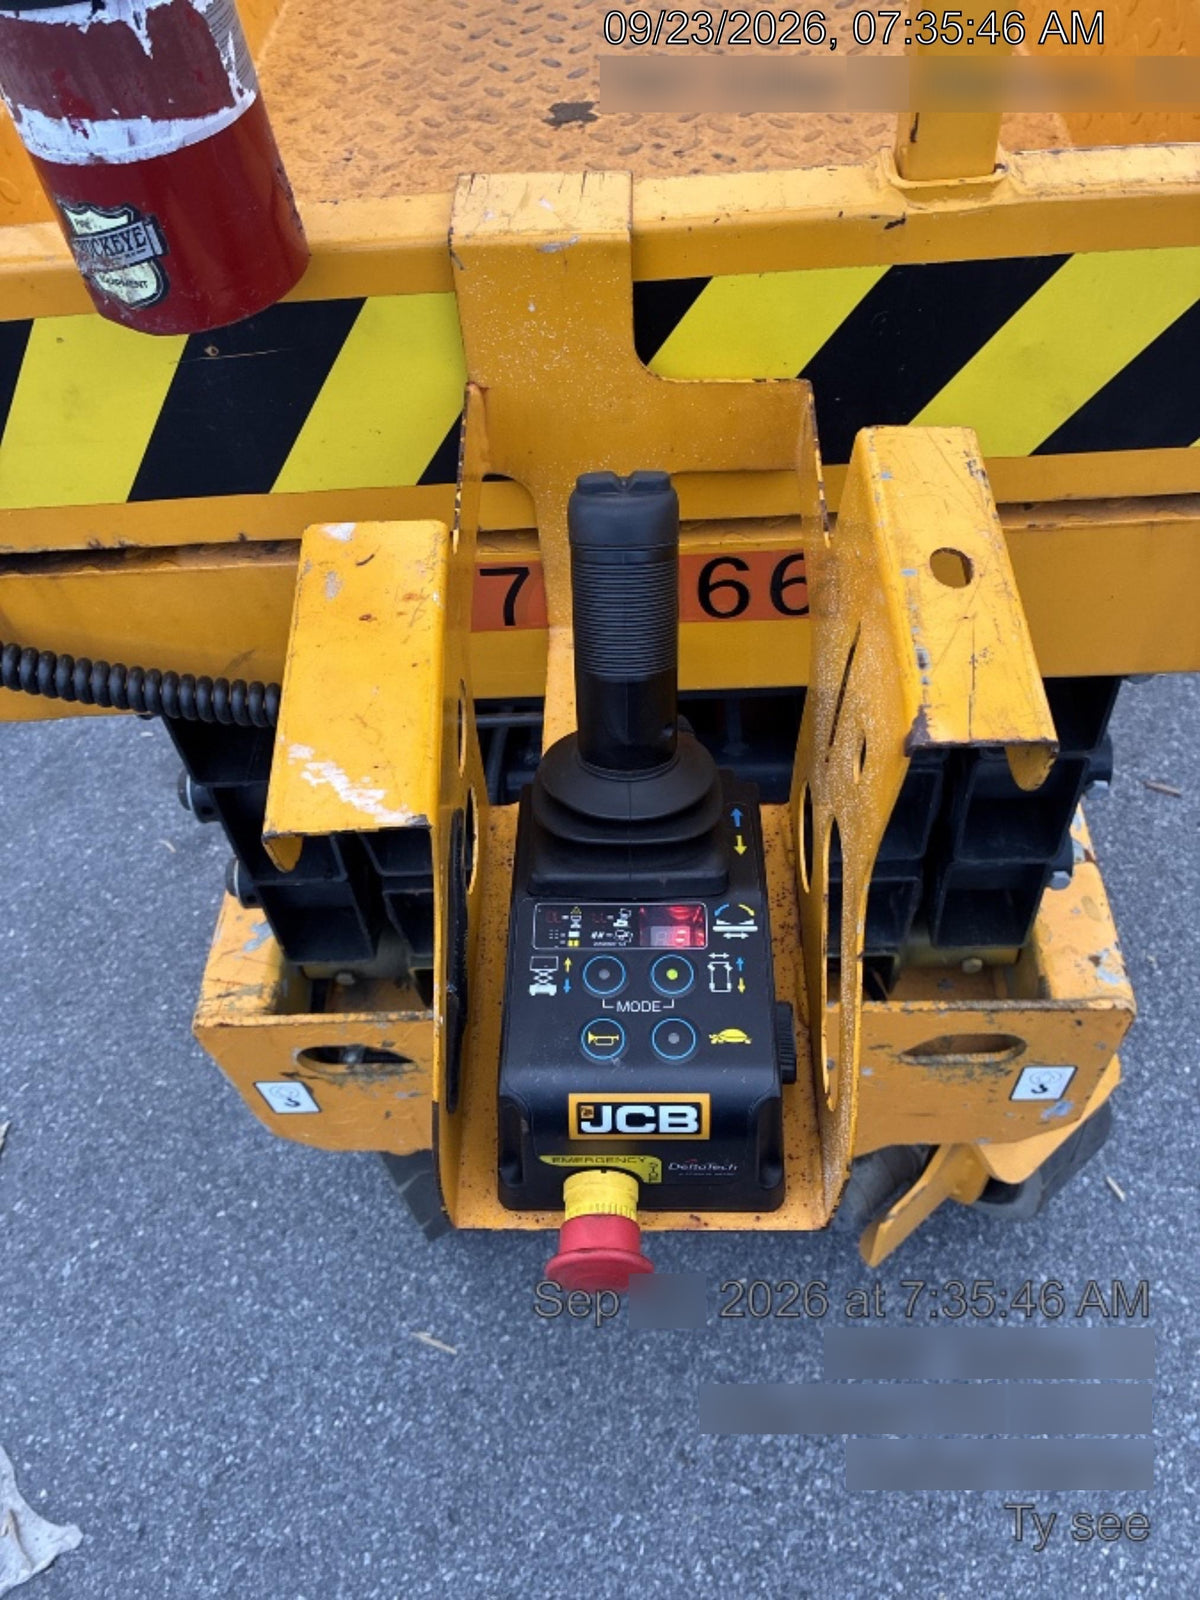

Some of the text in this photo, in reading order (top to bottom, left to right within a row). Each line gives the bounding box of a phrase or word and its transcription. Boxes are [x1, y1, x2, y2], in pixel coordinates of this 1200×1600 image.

[616, 1000, 662, 1012] MODE
[580, 1105, 699, 1133] JCB
[551, 1156, 646, 1164] EMERGENCY
